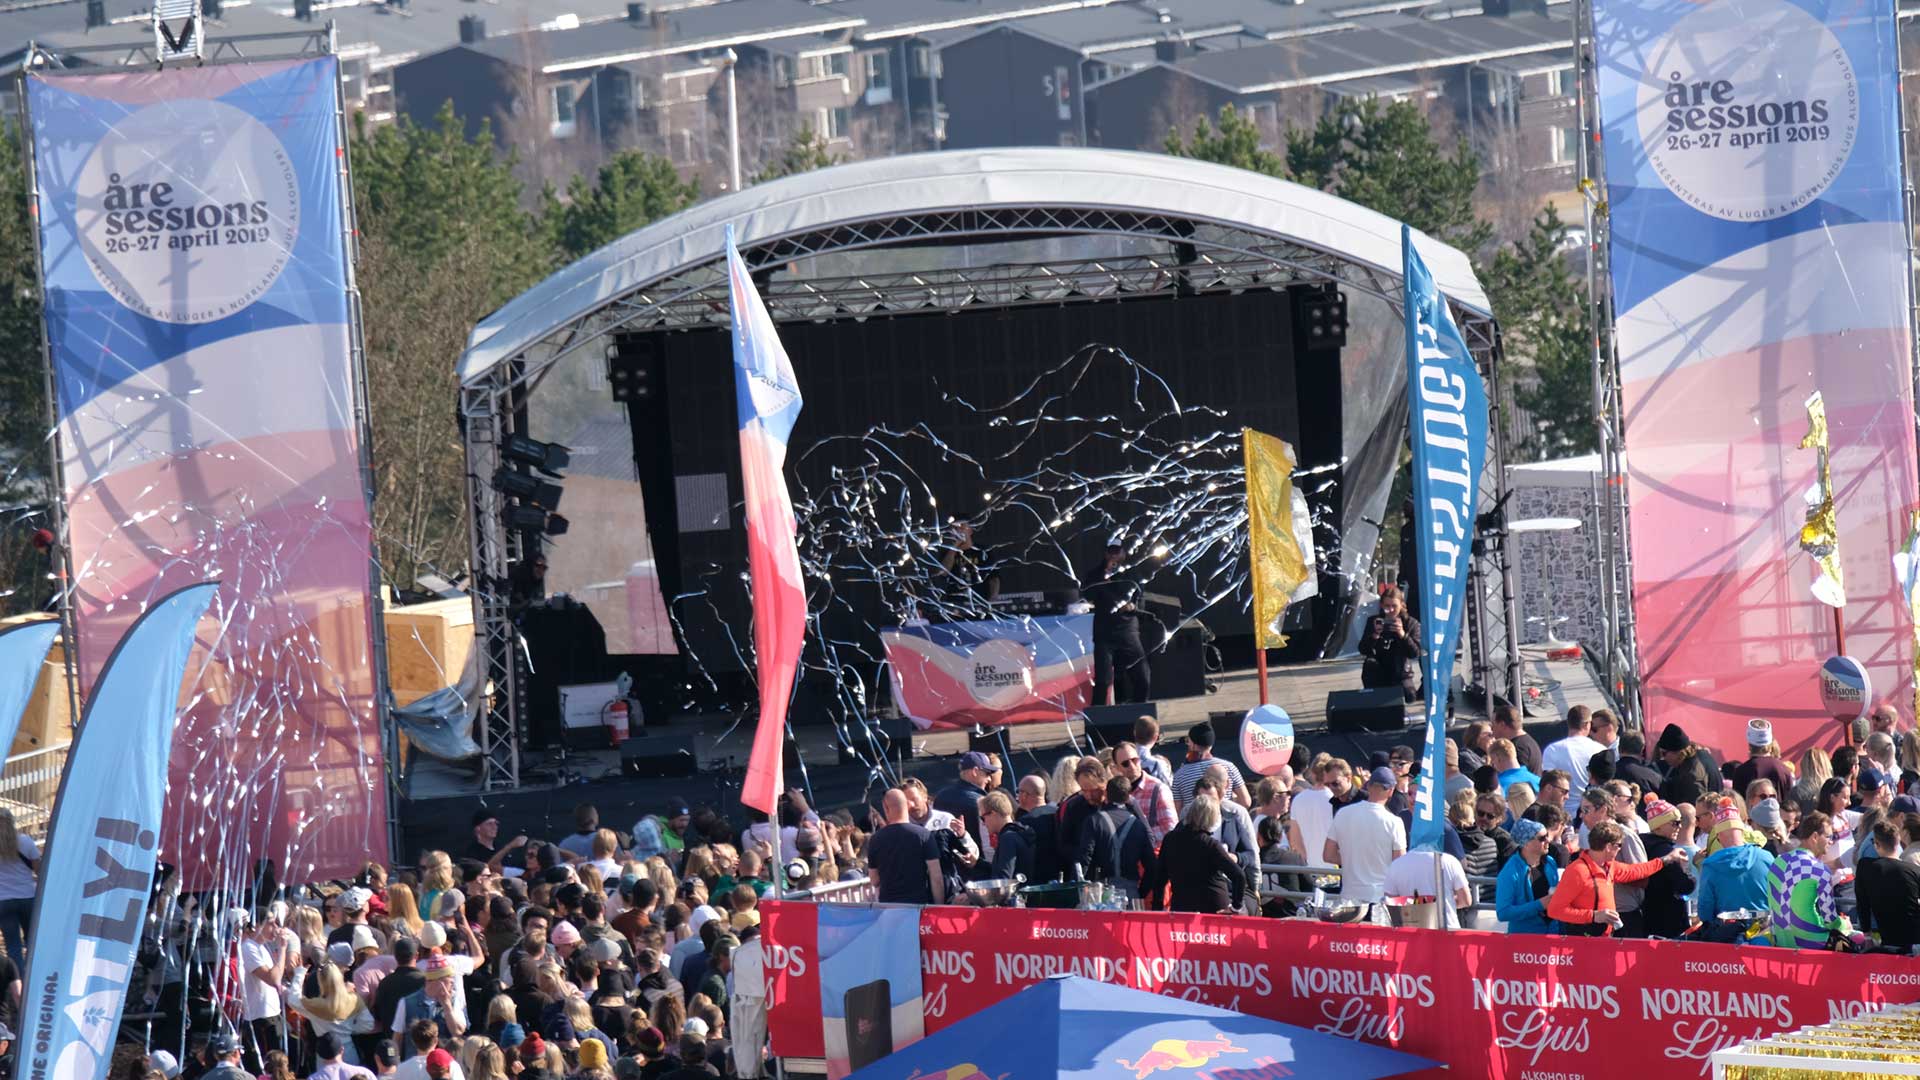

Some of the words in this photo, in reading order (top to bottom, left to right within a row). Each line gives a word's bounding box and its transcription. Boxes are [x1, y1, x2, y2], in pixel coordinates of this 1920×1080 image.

[1664, 71, 1735, 108] åre
[1666, 99, 1829, 134] sessions
[1667, 132, 1722, 151] 26-27
[1729, 126, 1780, 149] april
[1786, 125, 1830, 143] 2019
[1652, 155, 1714, 212] PRESENTERAS
[1719, 207, 1734, 218] AV
[1739, 207, 1776, 219] LUGER
[1791, 156, 1844, 209] NORRLANDS
[1840, 125, 1855, 154] LJUS
[103, 173, 174, 211] åre
[105, 200, 269, 236] sessions
[106, 235, 160, 254] 26-27
[167, 229, 219, 252] april
[225, 226, 270, 245] 2019
[157, 309, 171, 320] AV
[176, 310, 214, 321] LUGER
[229, 257, 285, 311] NORRLANDS
[974, 662, 996, 675] åre
[1033, 927, 1089, 940] EKOLOGISK
[1170, 931, 1227, 945] EKOLOGISK
[1330, 941, 1388, 956] EKOLOGISK
[1135, 956, 1273, 997] NORRLANDS
[1513, 952, 1573, 966] EKOLOGISK
[1684, 961, 1747, 975] EKOLOGISK
[1291, 965, 1435, 1007] NORRLANDS
[1472, 977, 1621, 1019] NORRLANDS
[35, 972, 58, 1054] ORIGINAL
[1313, 996, 1406, 1042] Ljus
[1640, 987, 1793, 1028] NORRLANDS
[1494, 1008, 1590, 1066] Ljus
